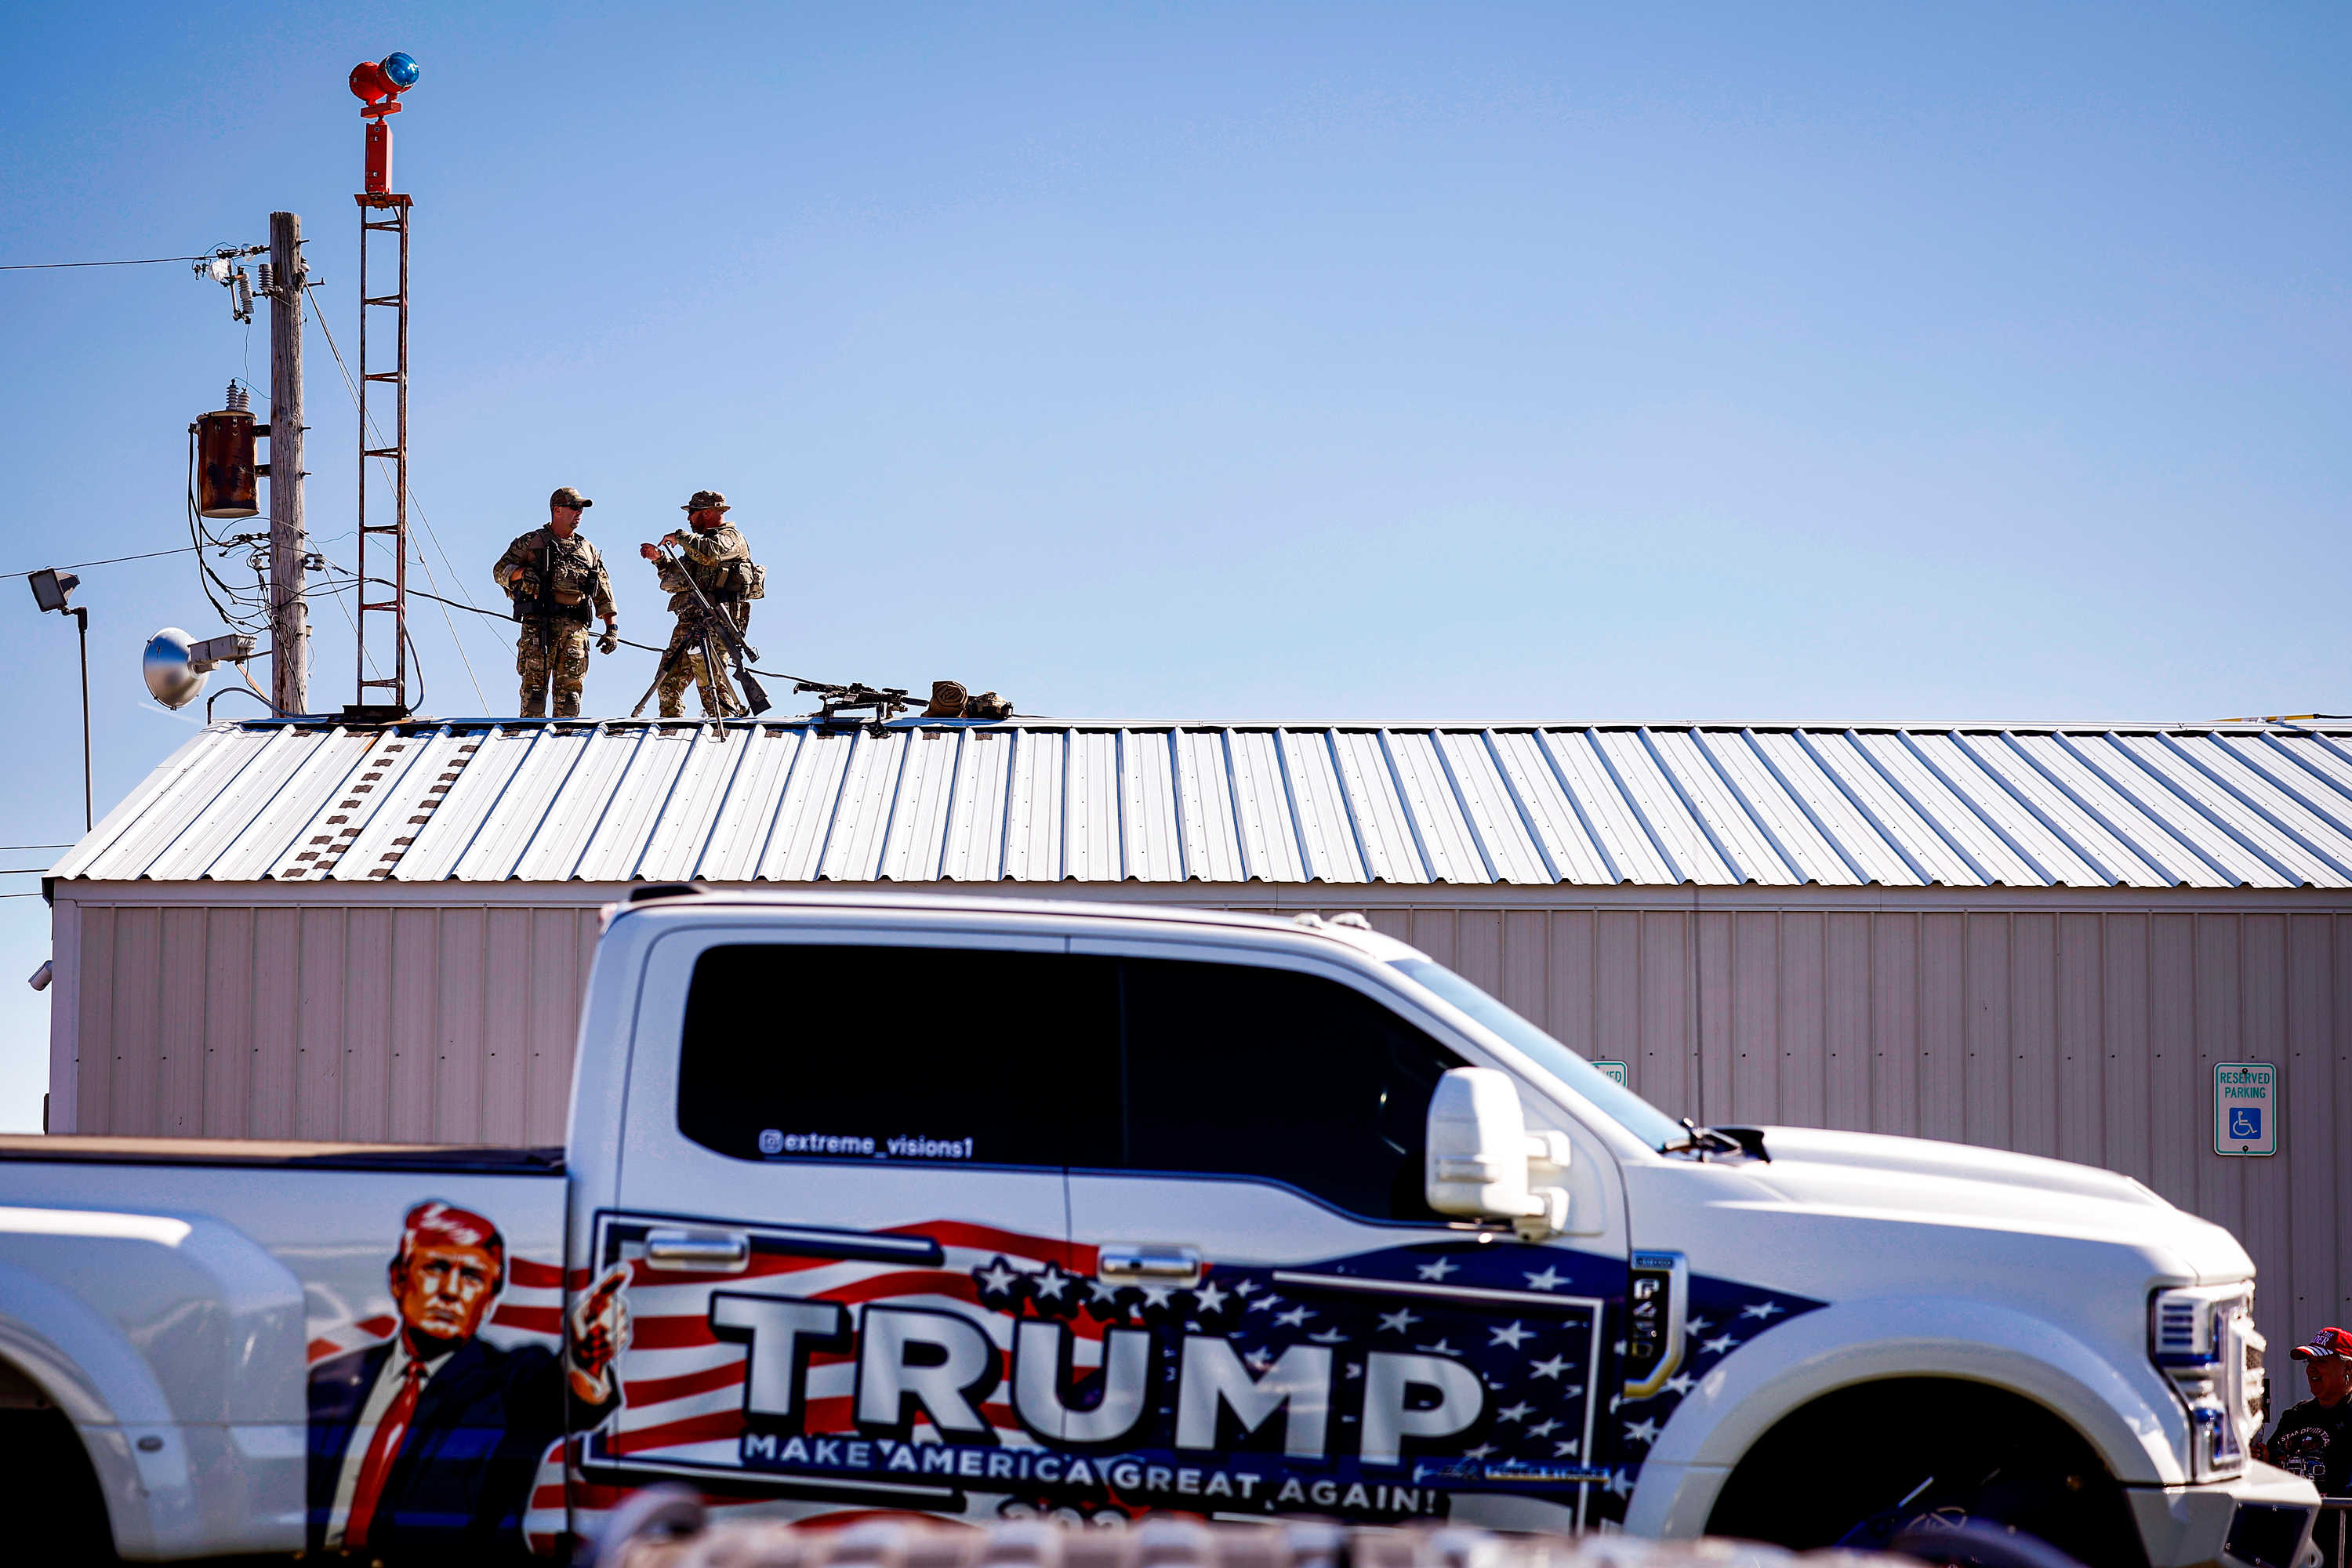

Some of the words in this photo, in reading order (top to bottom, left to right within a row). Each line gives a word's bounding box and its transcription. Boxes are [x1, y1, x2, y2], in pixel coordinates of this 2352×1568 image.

[2220, 1072, 2270, 1084] RESERVED
[2224, 1087, 2267, 1098] PARKING
[784, 1131, 974, 1158] extreme_visions1
[711, 1294, 1486, 1468] TRUMP
[744, 1434, 872, 1468] MAKE
[888, 1444, 1095, 1486] AMERICA
[1112, 1462, 1261, 1498] GREAT
[1278, 1477, 1436, 1513] AGAIN!
